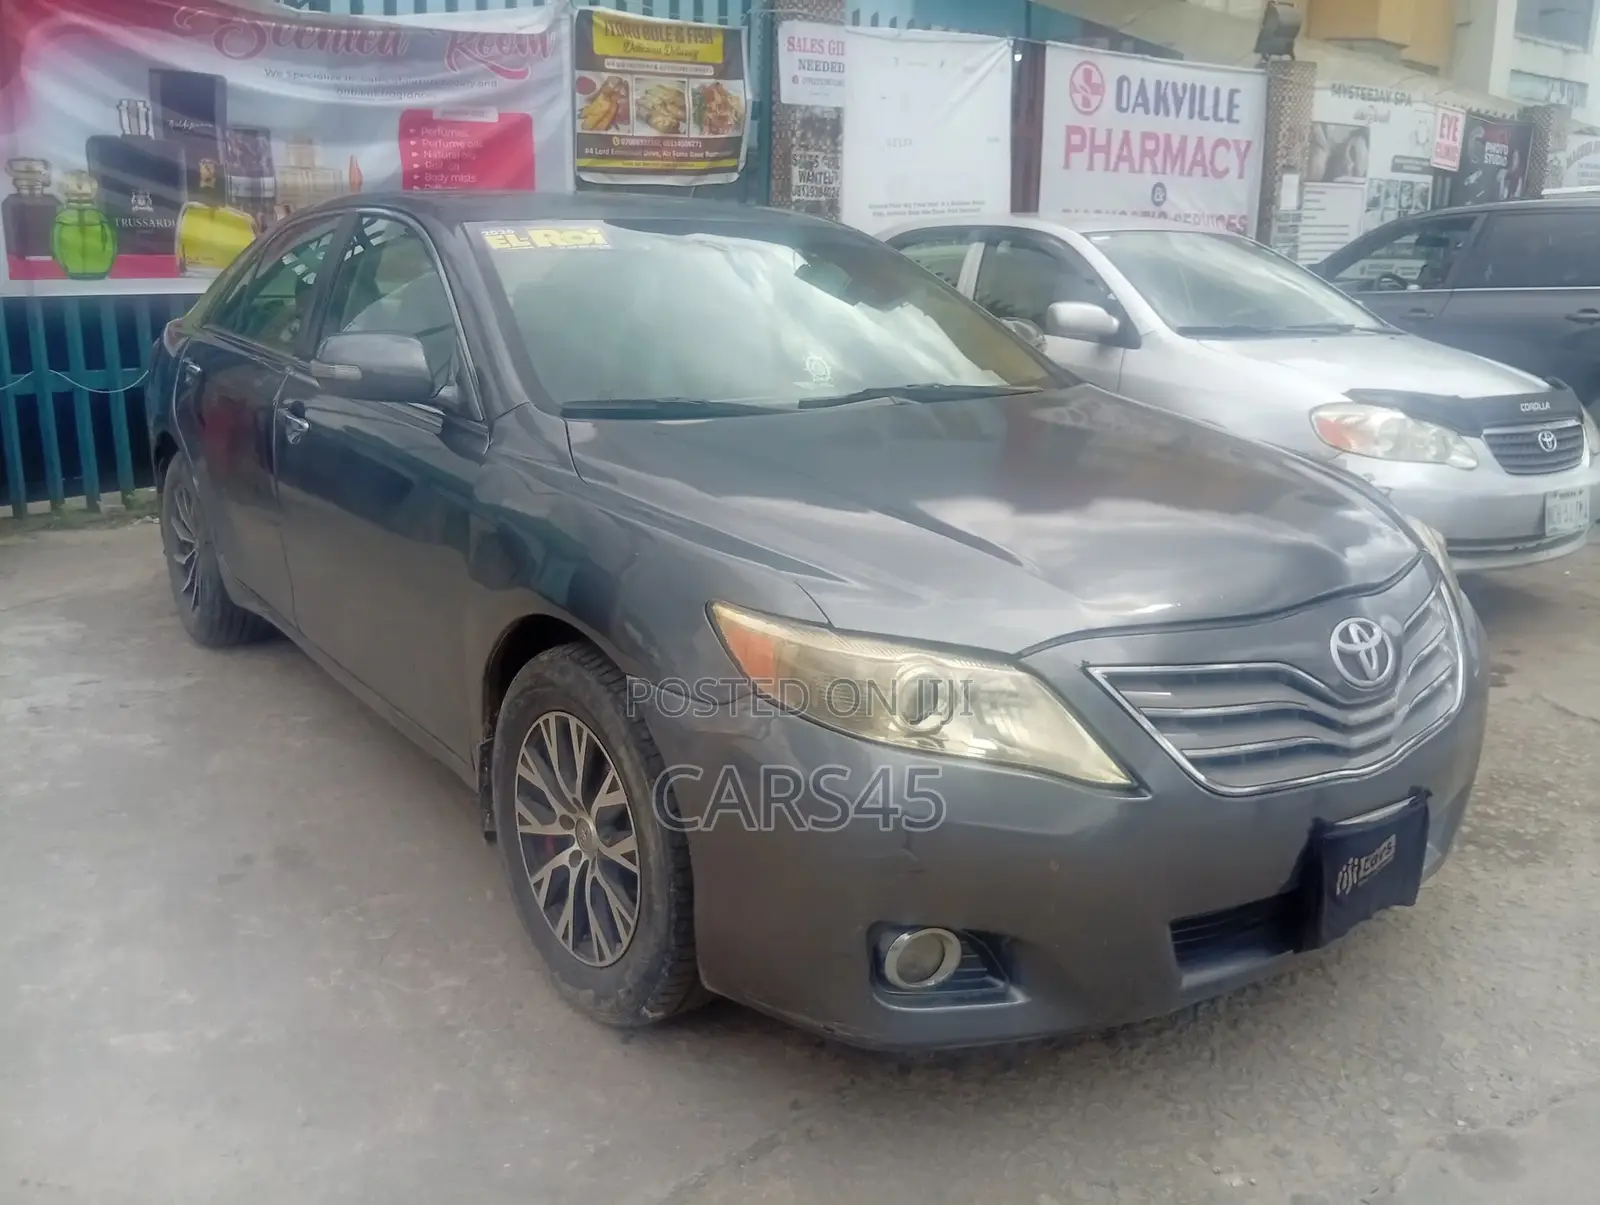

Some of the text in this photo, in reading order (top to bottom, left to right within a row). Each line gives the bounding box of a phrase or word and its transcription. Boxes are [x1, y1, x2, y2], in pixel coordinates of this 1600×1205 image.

[687, 29, 714, 45] FISH
[787, 36, 825, 54] SALES
[264, 68, 282, 78] We
[798, 59, 845, 73] NEEDED
[1115, 74, 1241, 124] OAKVILLE
[1062, 124, 1252, 180] PHARMACY
[424, 172, 477, 184] Body mists
[115, 216, 177, 229] TRUSSARDI
[484, 234, 534, 250] EL
[1520, 401, 1551, 412] COROLLA
